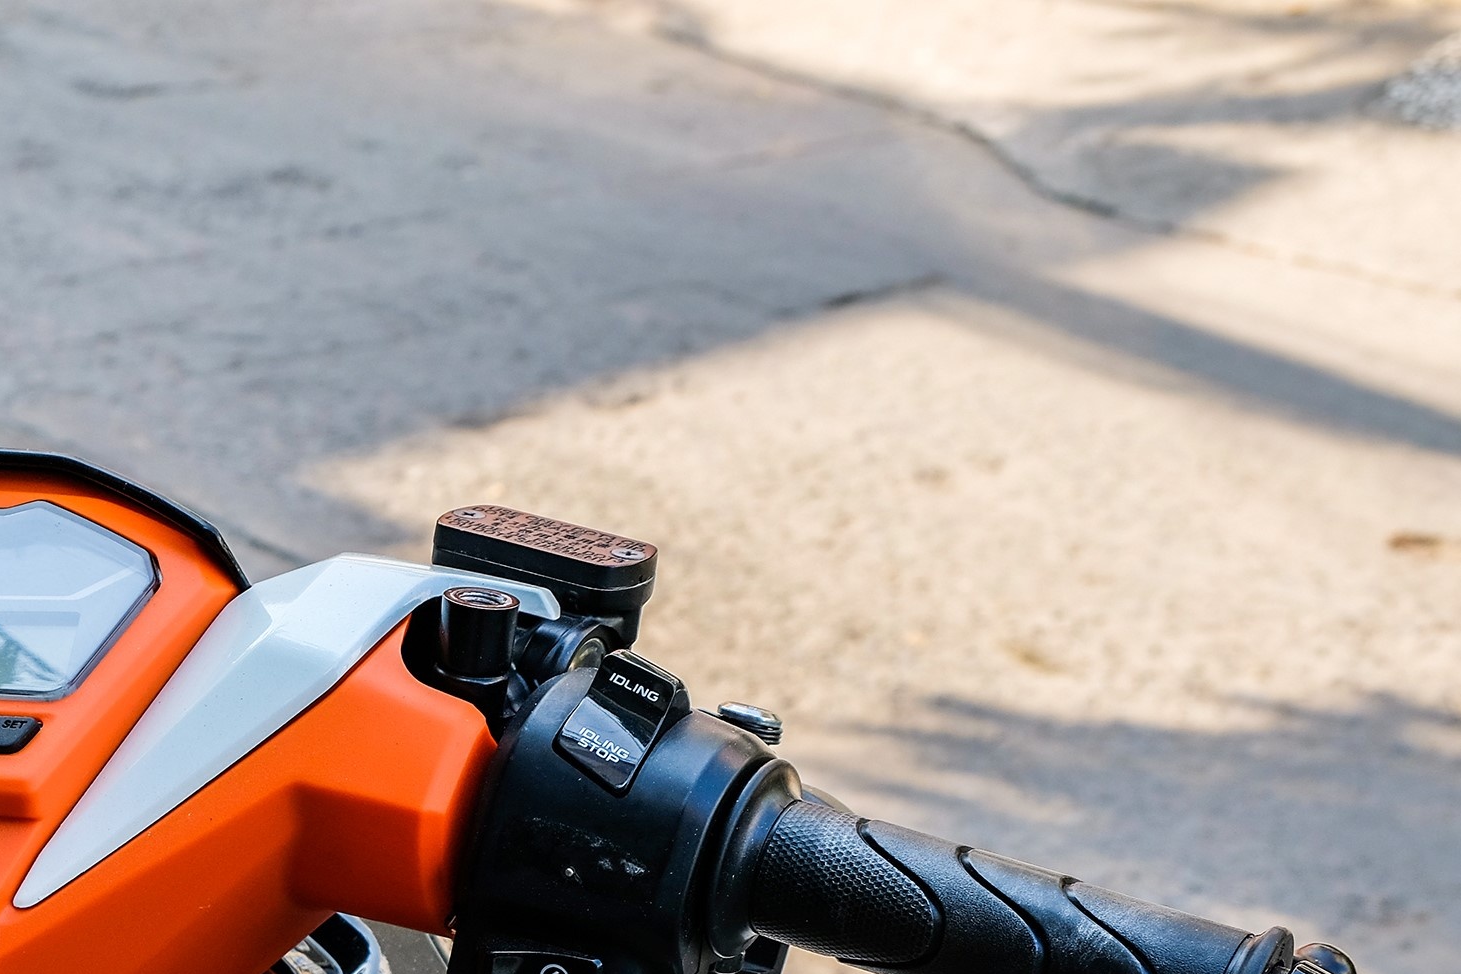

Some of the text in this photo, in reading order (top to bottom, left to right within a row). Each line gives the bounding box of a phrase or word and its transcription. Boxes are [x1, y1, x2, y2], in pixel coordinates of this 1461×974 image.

[609, 672, 659, 702] IDLING
[1, 719, 28, 729] SET
[577, 737, 620, 763] STOP
[579, 727, 630, 759] IDLING
